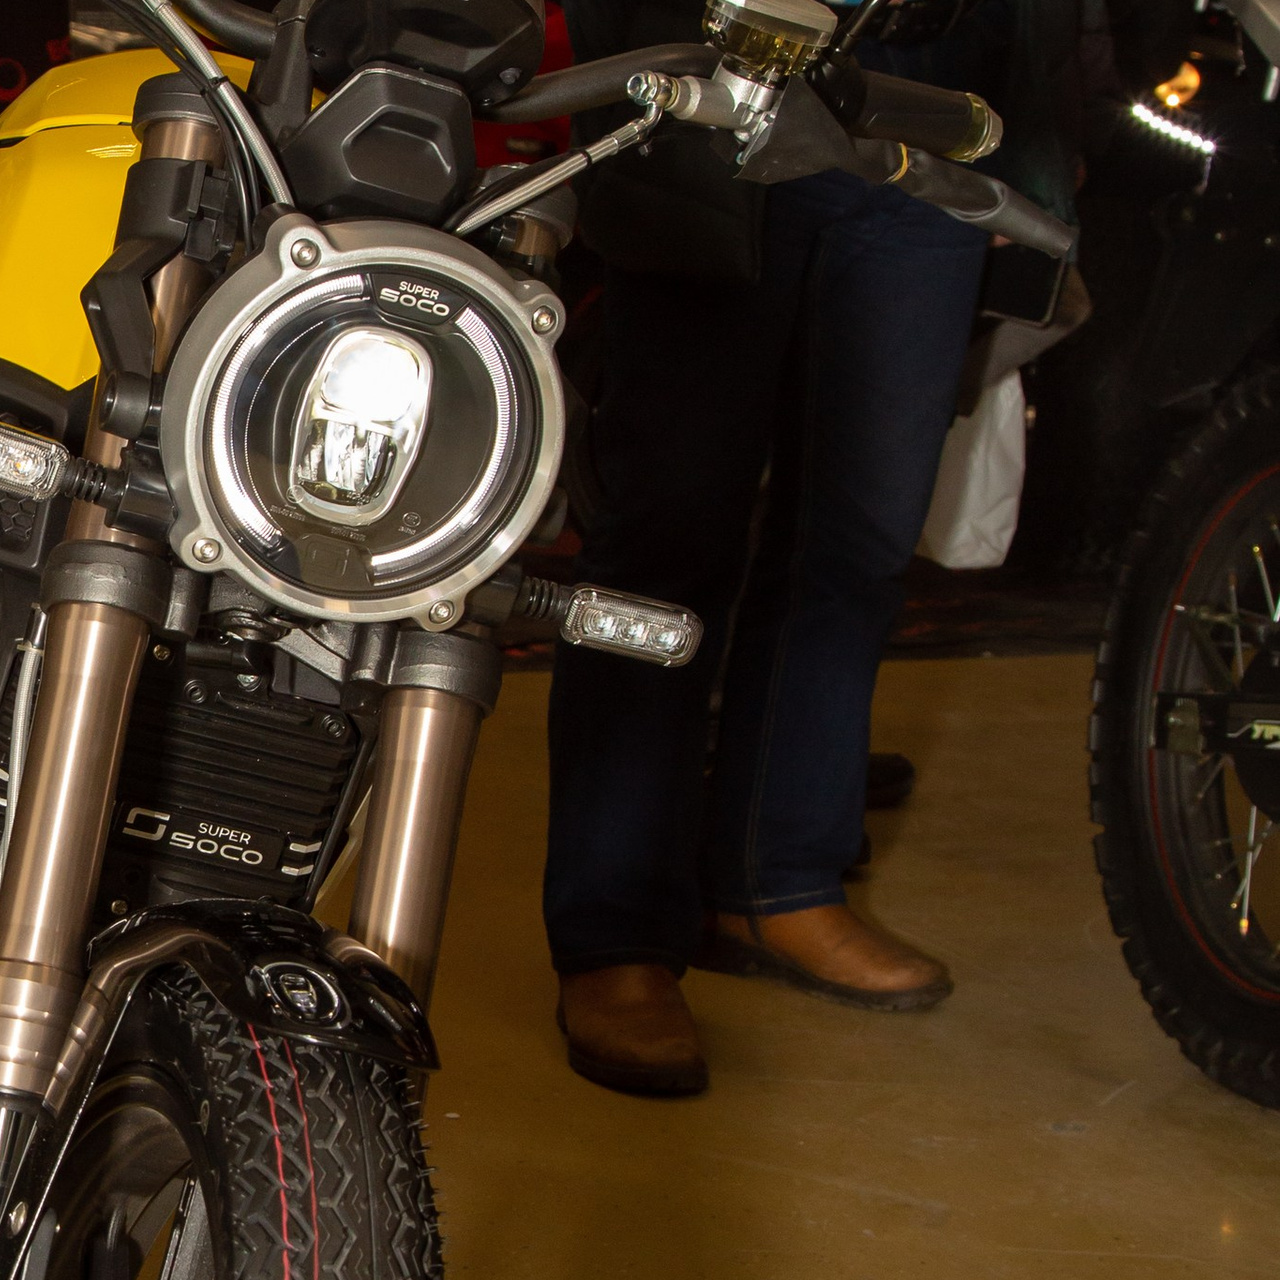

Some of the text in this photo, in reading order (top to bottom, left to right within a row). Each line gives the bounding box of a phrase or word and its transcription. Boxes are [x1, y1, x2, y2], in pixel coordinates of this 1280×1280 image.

[379, 288, 451, 317] SOCO
[399, 280, 439, 300] SUPER
[198, 821, 252, 846] SUPER
[170, 833, 264, 867] SOCO
